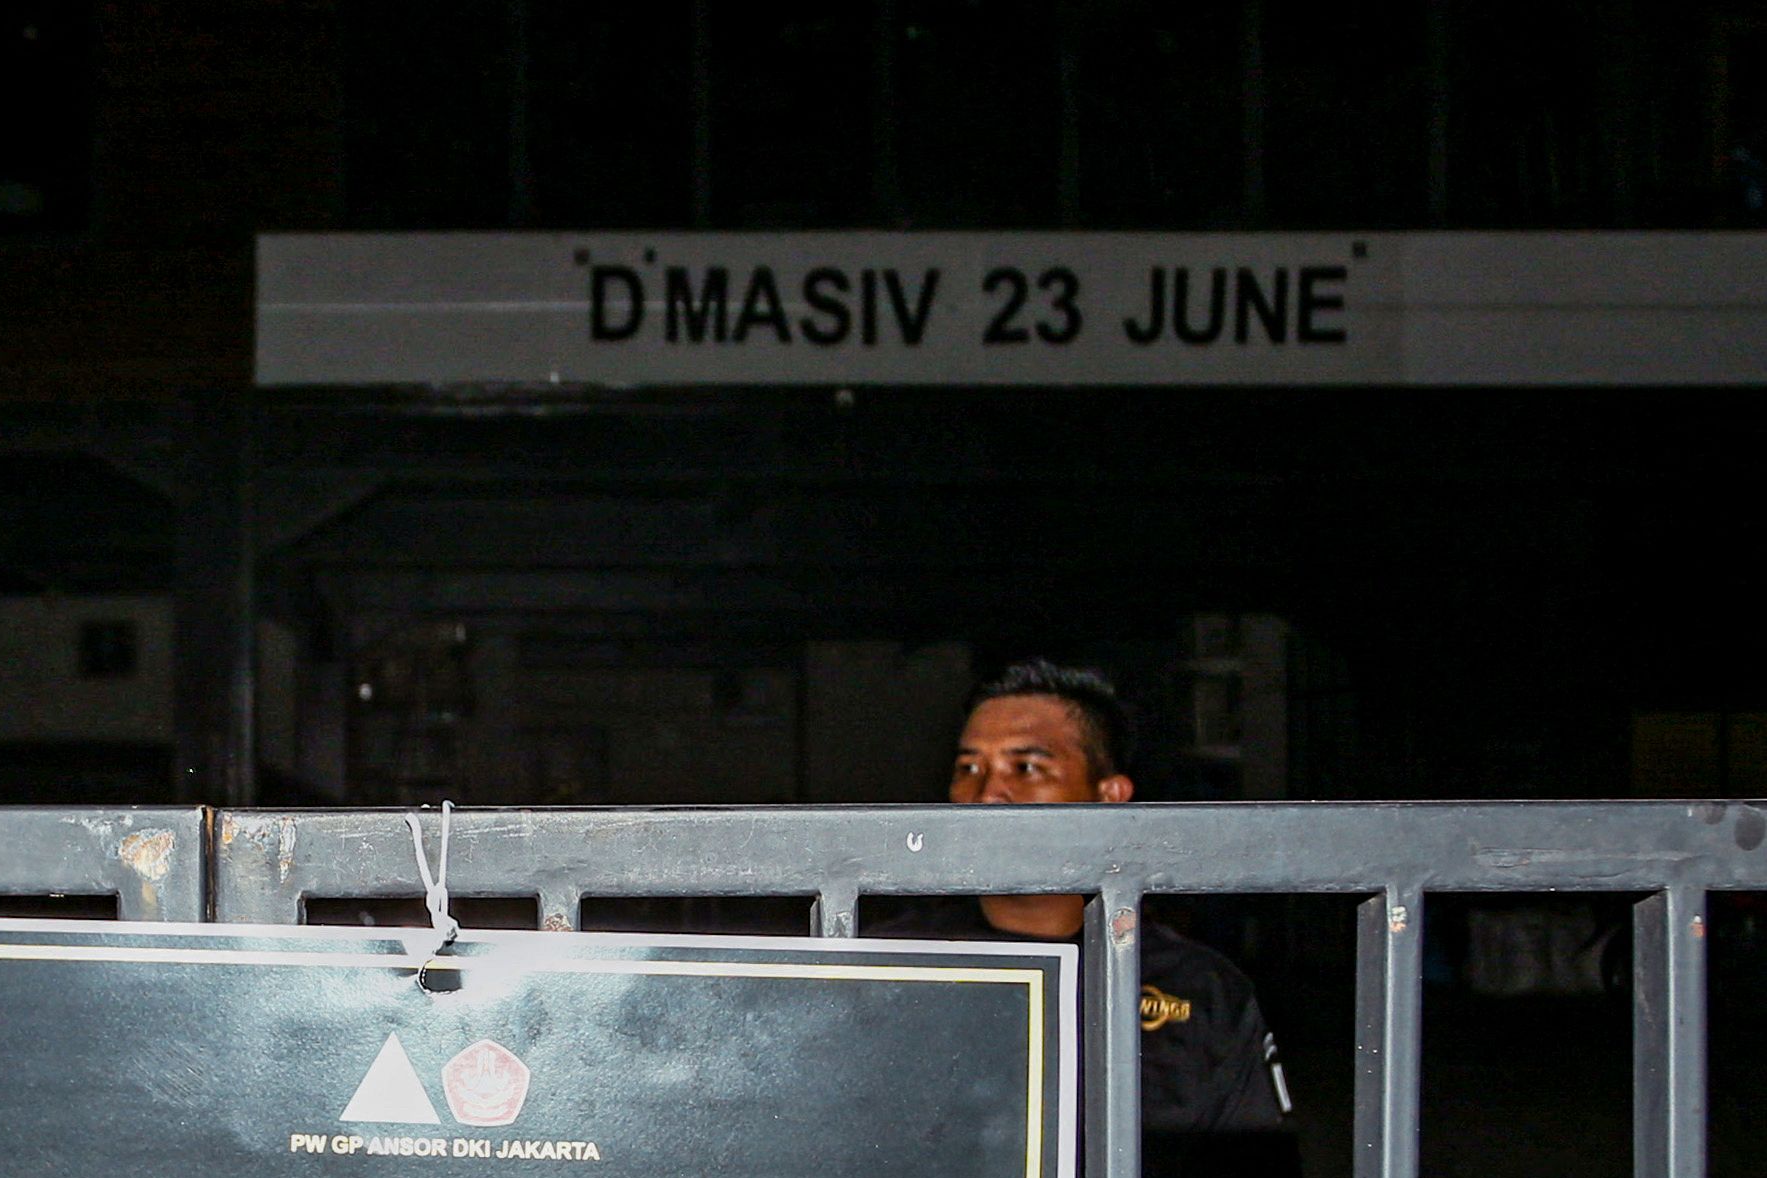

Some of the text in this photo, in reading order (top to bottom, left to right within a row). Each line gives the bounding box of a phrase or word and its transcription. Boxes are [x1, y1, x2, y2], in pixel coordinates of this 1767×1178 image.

[981, 265, 1084, 345] 23
[290, 1134, 600, 1160] PW GP ANSOR DKI JAKARTA
